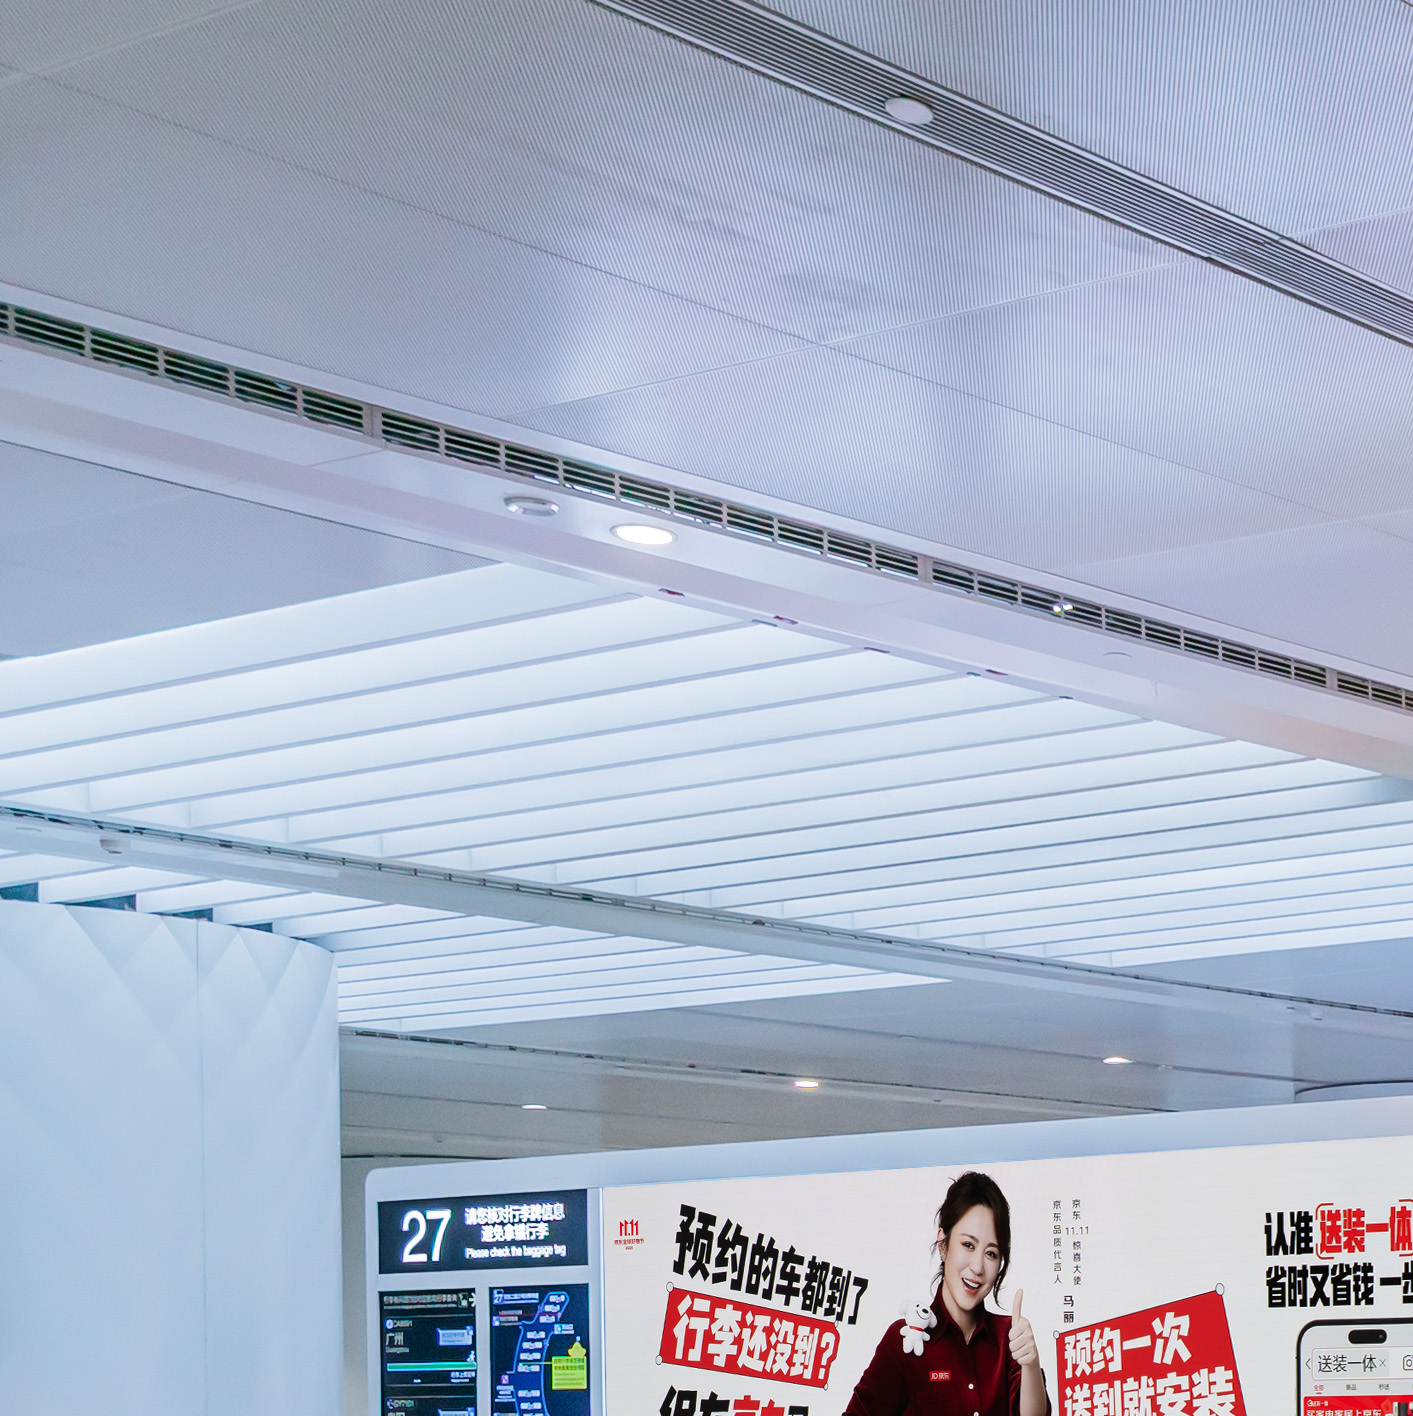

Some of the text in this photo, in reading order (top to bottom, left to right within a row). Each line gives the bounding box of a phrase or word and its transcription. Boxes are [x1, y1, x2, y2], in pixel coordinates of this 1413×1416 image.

[402, 1209, 452, 1263] 27
[620, 1219, 638, 1236] 11.11
[1053, 1200, 1062, 1284] 京东品质代言人
[672, 1203, 869, 1325] 预约的车都到了
[672, 1294, 836, 1380] 行李还没到?
[1063, 1295, 1074, 1323] 马丽
[1064, 1311, 1192, 1379] 预约一次
[1318, 1353, 1377, 1373] 送装一体
